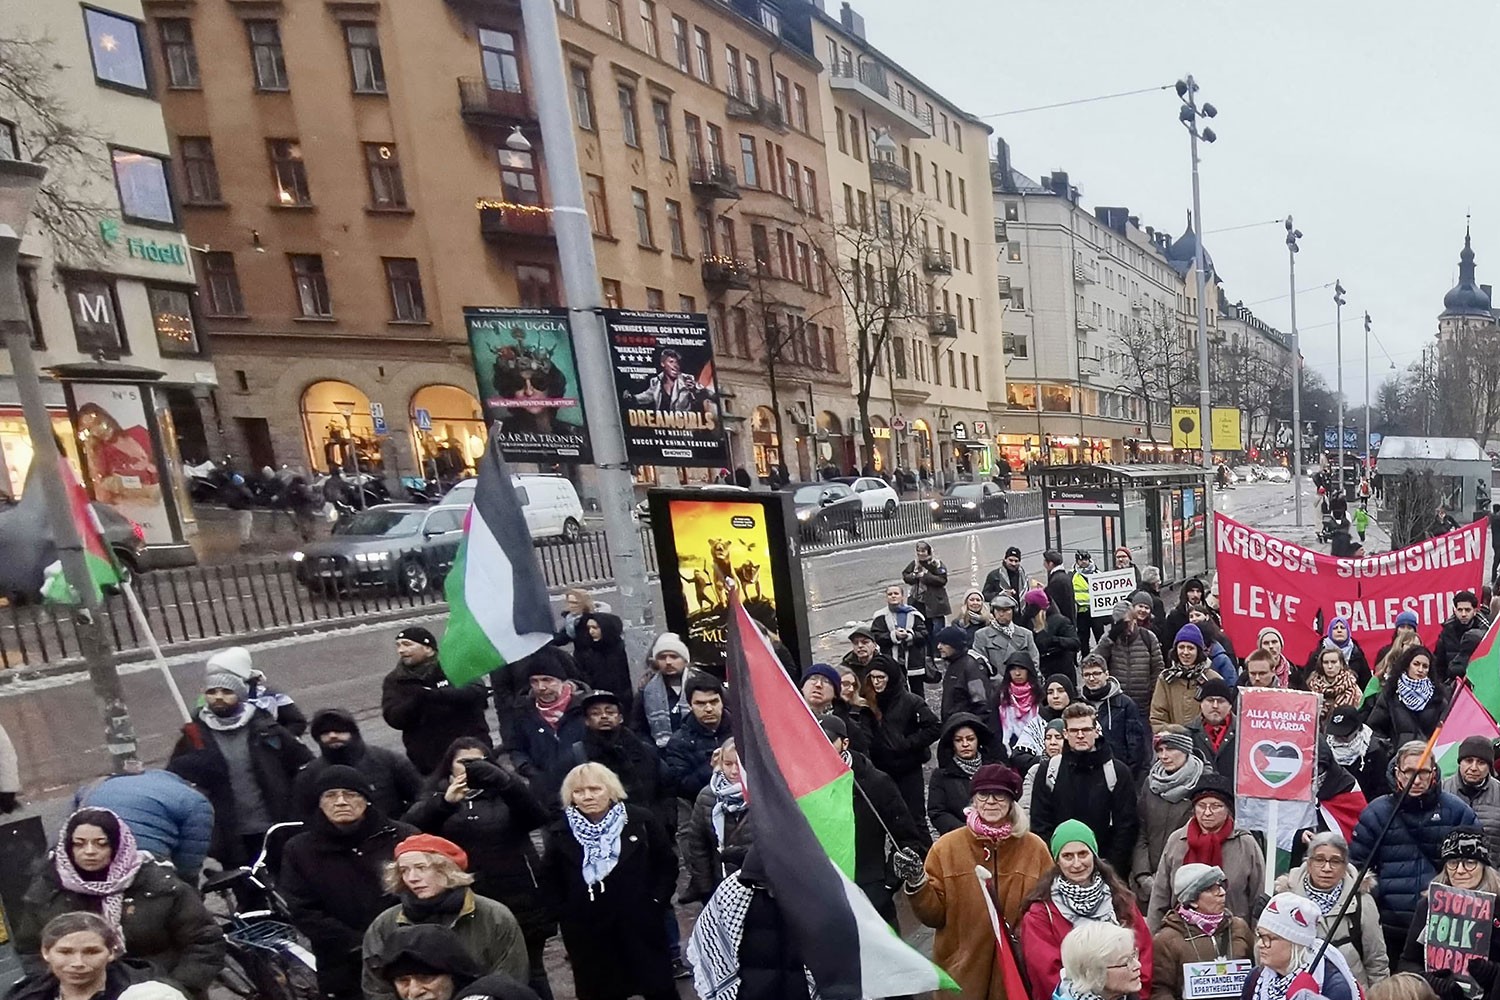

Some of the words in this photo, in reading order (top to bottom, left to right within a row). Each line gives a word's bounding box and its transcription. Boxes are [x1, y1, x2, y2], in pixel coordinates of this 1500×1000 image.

[78, 293, 109, 323] M
[628, 408, 716, 431] DREAMGIRLS
[508, 432, 521, 442] ÅR
[523, 433, 538, 443] PÅ
[537, 433, 584, 445] TRONEN
[1051, 490, 1057, 499] F
[1217, 519, 1318, 575] KROSSA
[1336, 526, 1481, 579] SIONISMEN
[1092, 578, 1133, 592] STOPPA
[1232, 582, 1301, 623] LEVE
[1246, 709, 1270, 720] ALLA
[1271, 710, 1297, 721] BARN
[1297, 711, 1312, 722] ÄR
[1251, 720, 1272, 730] LIKA
[1273, 720, 1306, 733] VÄRDA
[1432, 890, 1491, 920] STOPPA
[1428, 914, 1484, 949] FOLK-
[1427, 945, 1489, 977] MORDE
[1211, 974, 1233, 985] HANDEL
